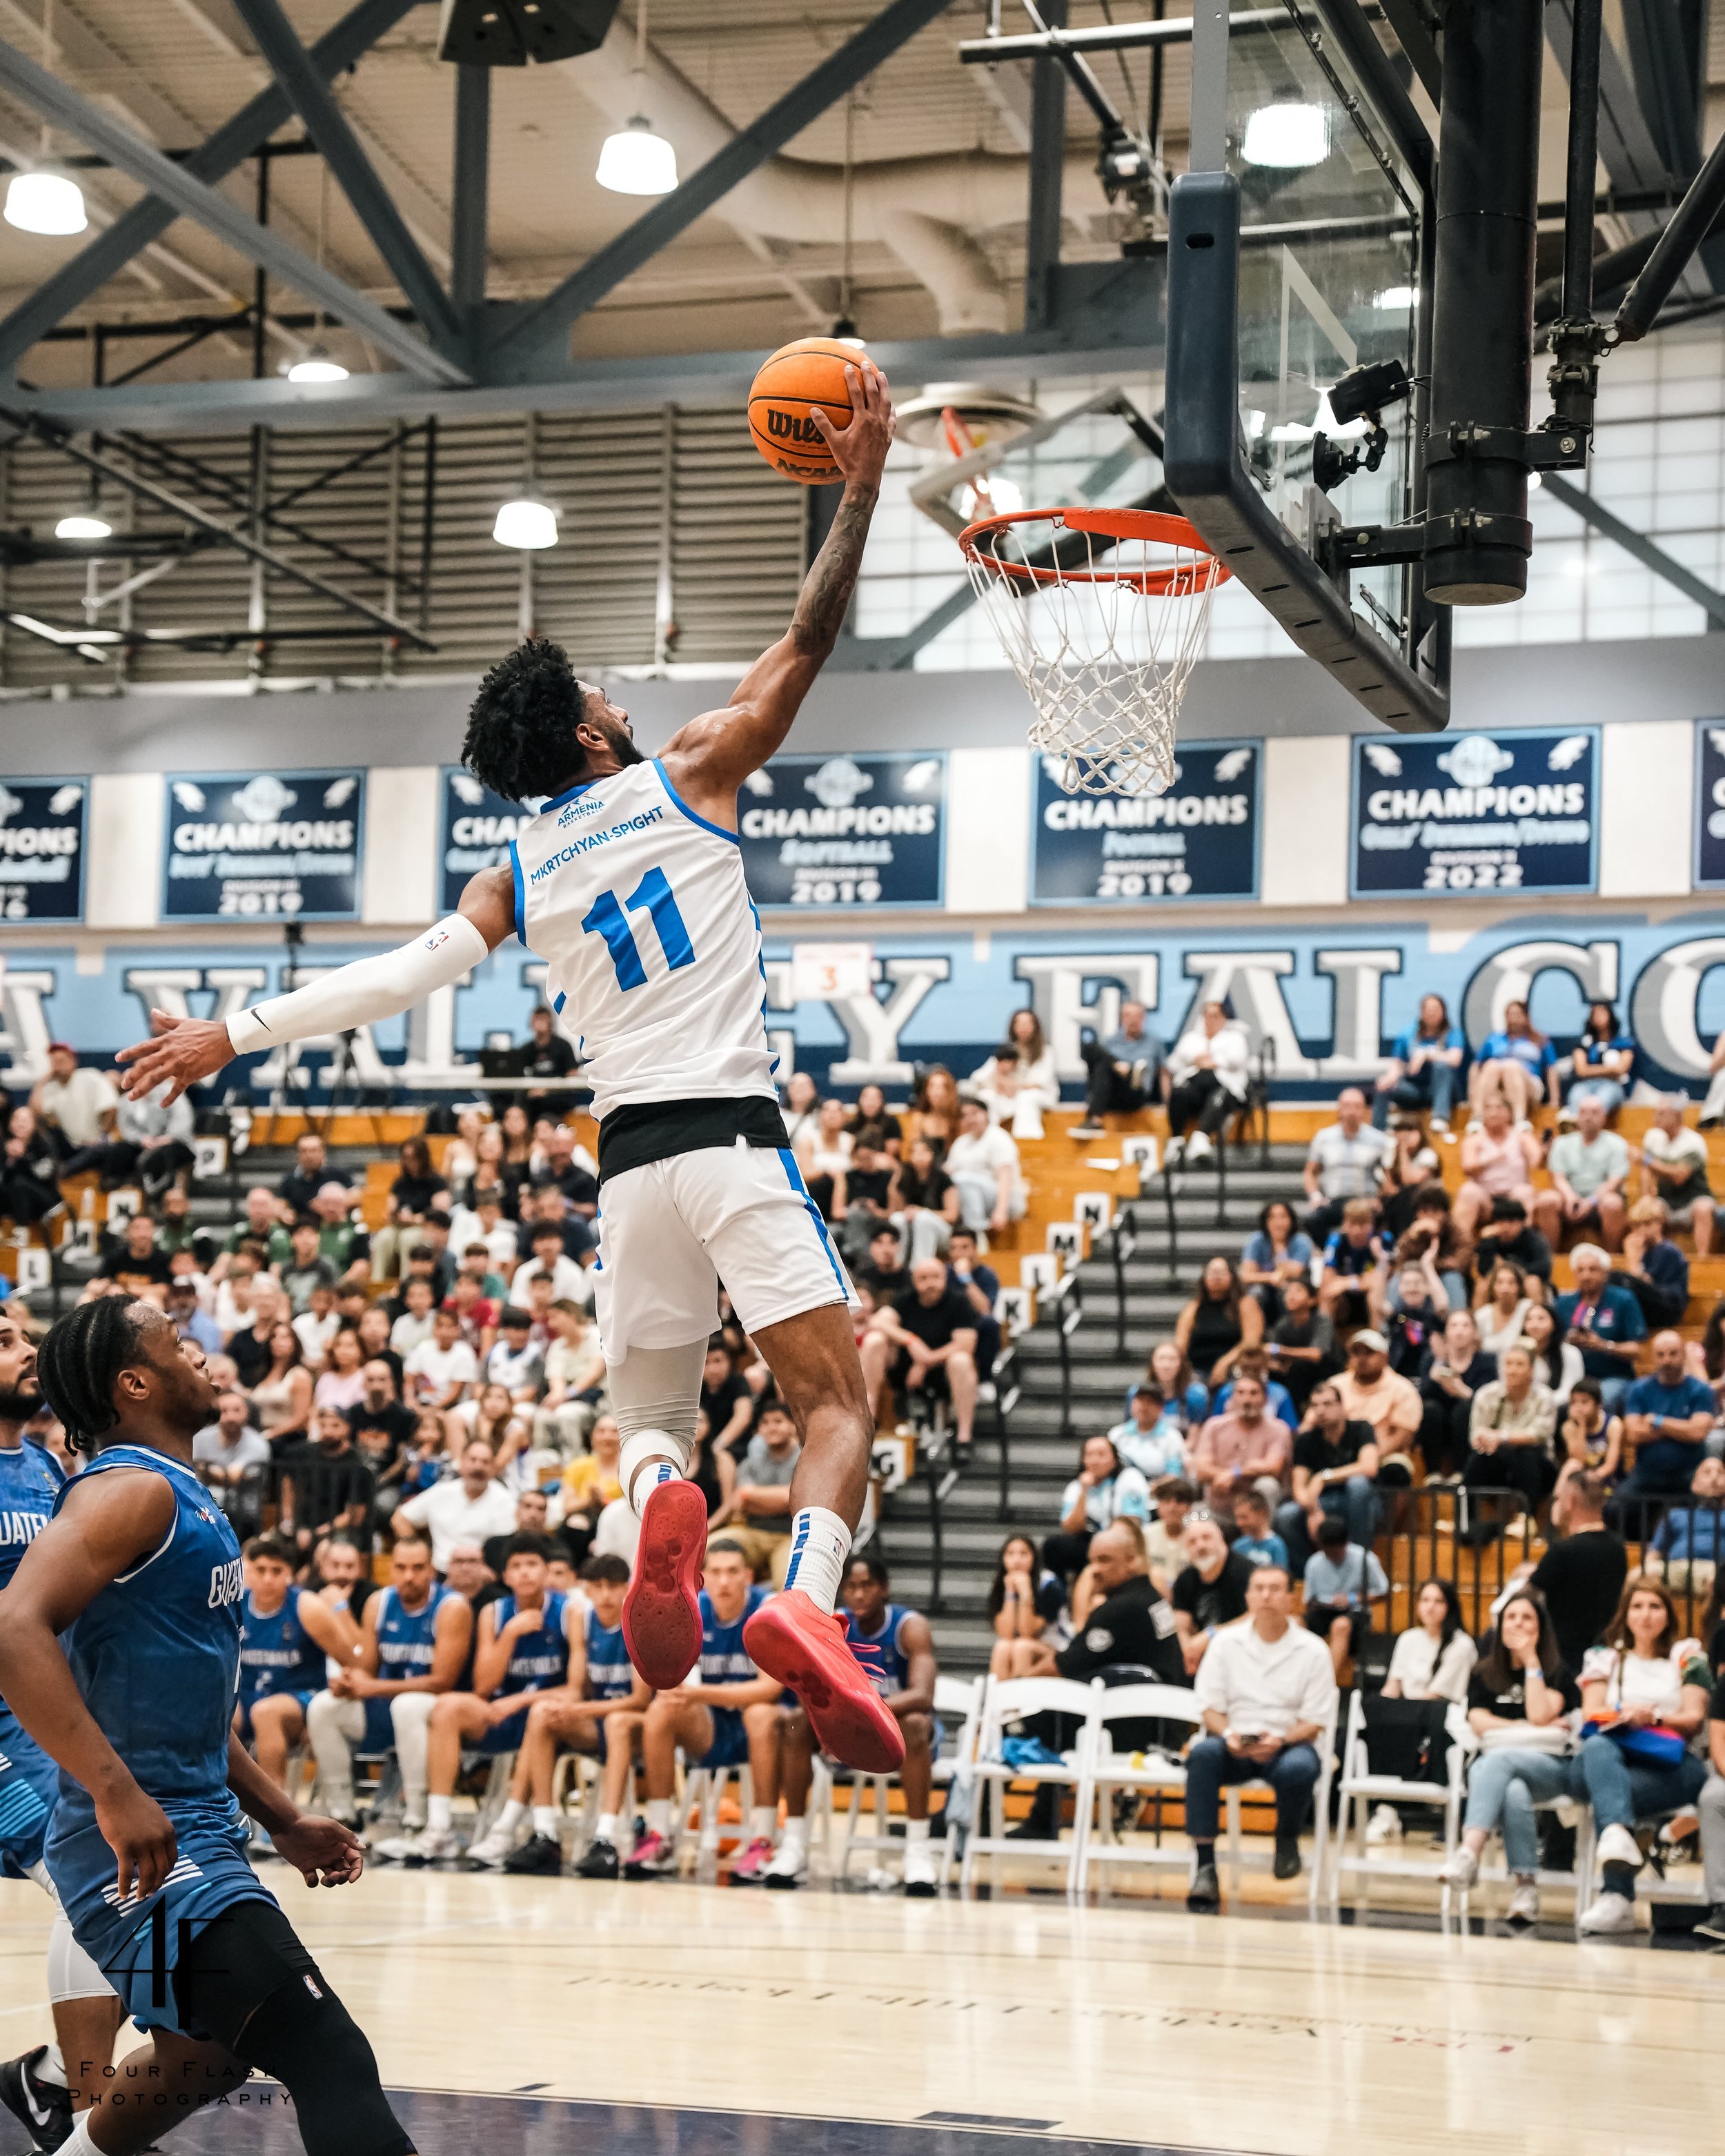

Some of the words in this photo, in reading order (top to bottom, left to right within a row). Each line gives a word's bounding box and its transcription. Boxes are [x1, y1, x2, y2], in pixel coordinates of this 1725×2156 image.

[768, 408, 826, 445] Wils
[558, 800, 605, 827] ARMENIA
[1044, 795, 1248, 831] CHAMPIONS
[1368, 783, 1585, 821] CHAMPIONS
[562, 808, 604, 829] BASKETBALL
[742, 804, 935, 839] CHAMPIONS
[0, 827, 78, 856] IONS
[174, 820, 354, 853] CHAMPIONS
[531, 806, 664, 885] MKRTCHYAN-SPIGHT
[790, 880, 883, 903] 2019
[1096, 872, 1192, 896] 2019
[1423, 864, 1524, 889] 2022
[218, 891, 304, 916] 2019
[581, 866, 696, 992] 11
